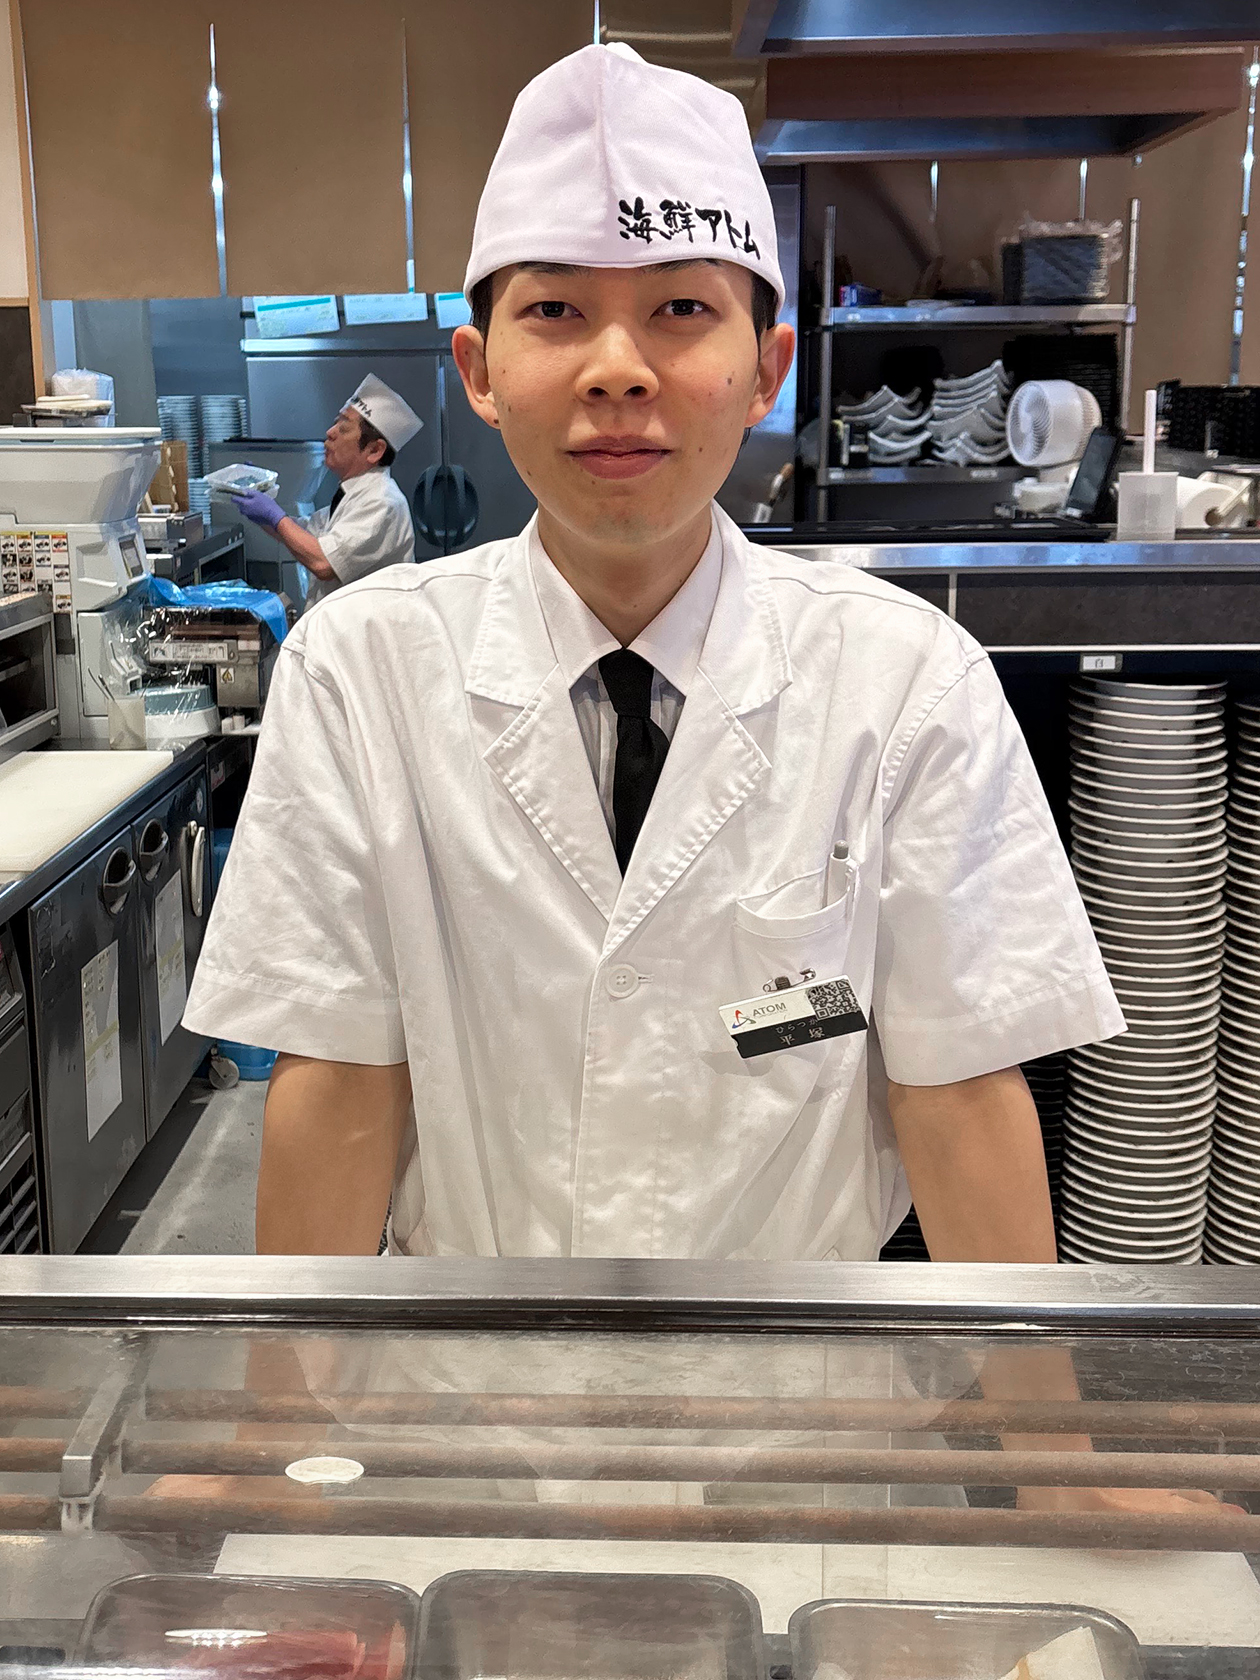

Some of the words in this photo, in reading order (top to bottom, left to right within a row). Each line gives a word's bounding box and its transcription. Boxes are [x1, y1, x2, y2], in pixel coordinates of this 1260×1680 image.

[618, 196, 761, 260] 海鮮アトム
[753, 1001, 787, 1017] ATOM
[775, 1018, 818, 1034] ひらつか
